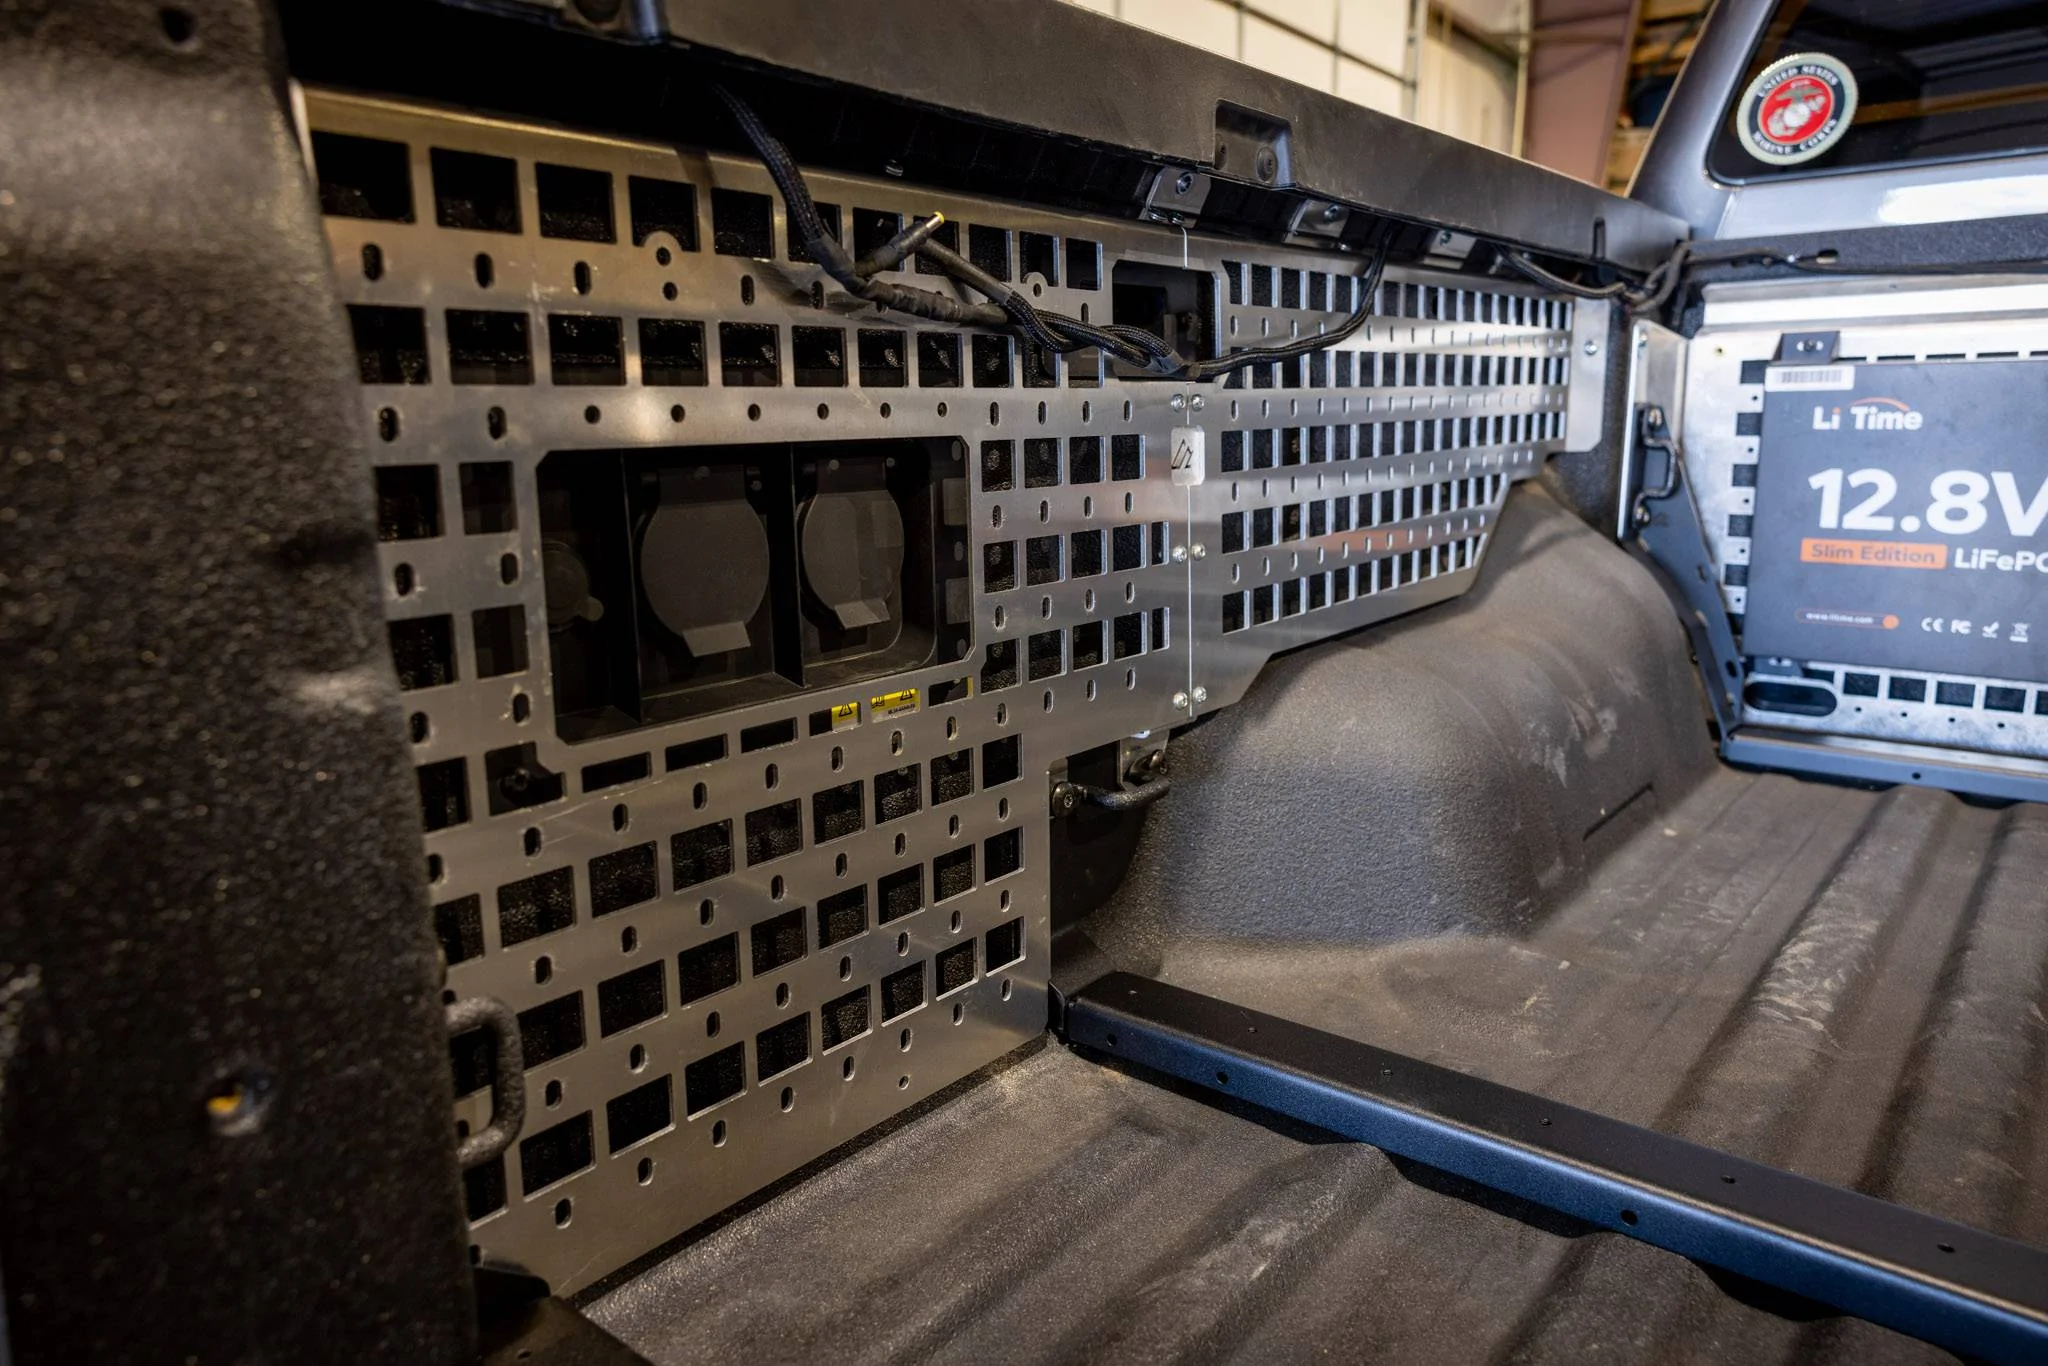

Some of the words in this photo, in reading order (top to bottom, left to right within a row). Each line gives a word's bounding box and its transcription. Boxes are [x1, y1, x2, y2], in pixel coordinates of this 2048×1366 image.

[1812, 405, 1841, 430] Li
[1850, 405, 1923, 430] Time
[1808, 468, 2048, 537] 12.8V
[1811, 543, 1854, 559] Slim
[1860, 546, 1936, 564] Edition
